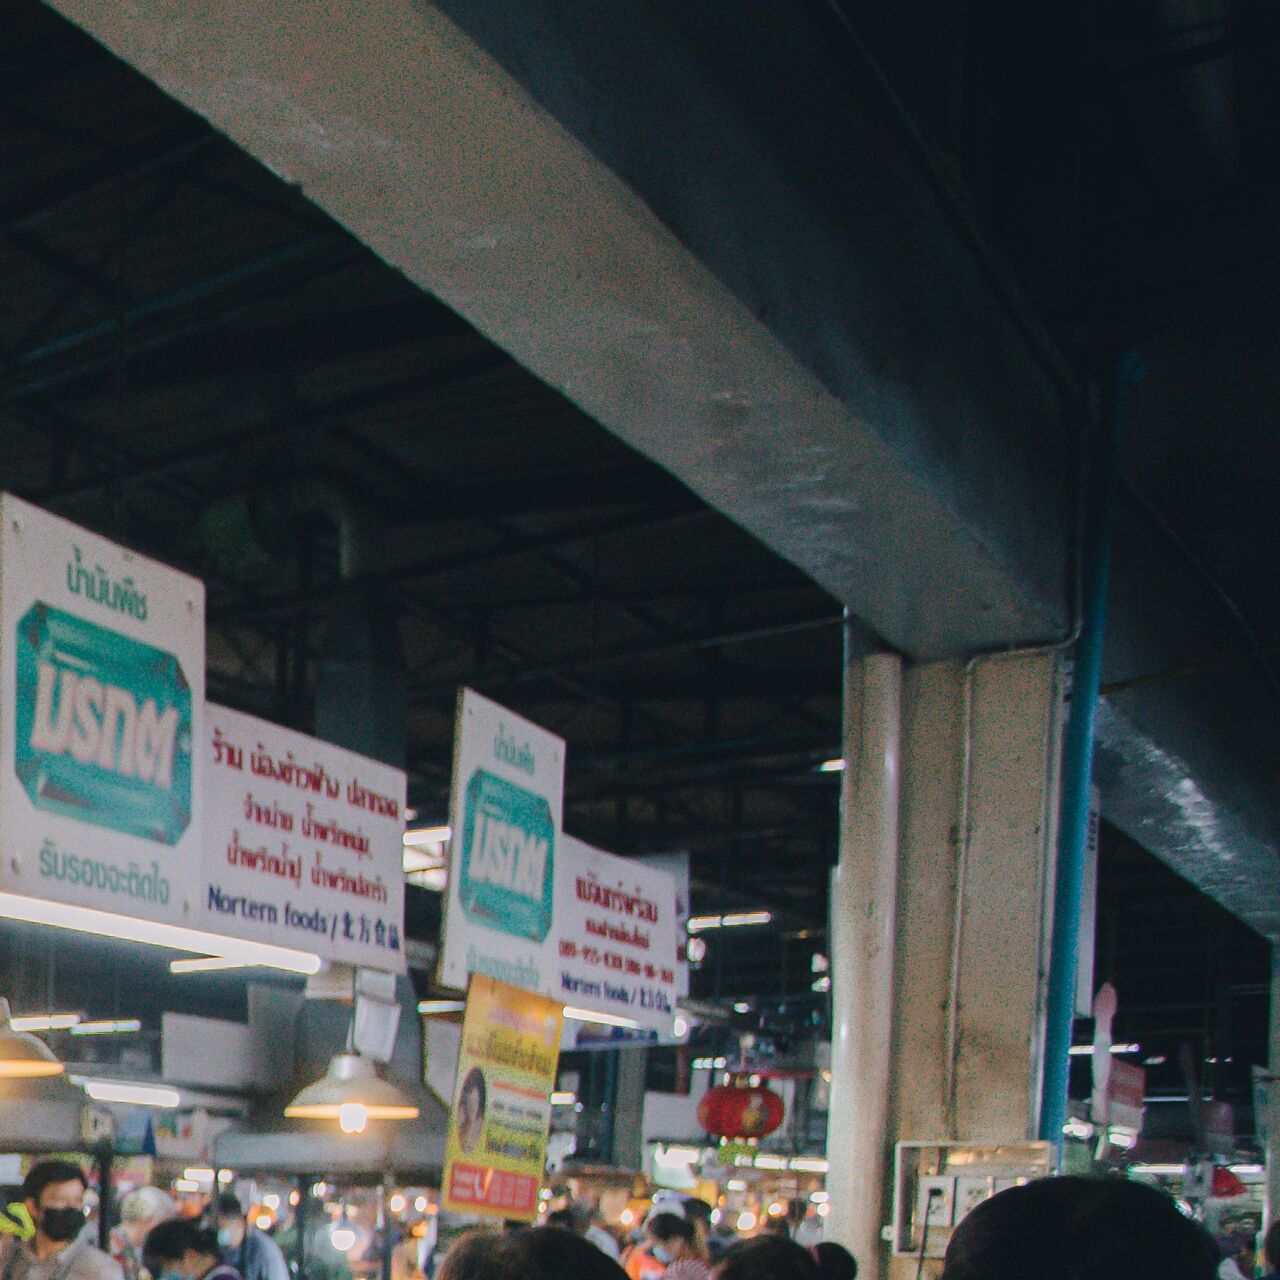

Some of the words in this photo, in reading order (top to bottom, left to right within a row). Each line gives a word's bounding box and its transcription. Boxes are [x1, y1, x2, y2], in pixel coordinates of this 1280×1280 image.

[30, 660, 179, 789] มรกต
[212, 727, 244, 771] ร้าน
[208, 883, 278, 925] Nortern
